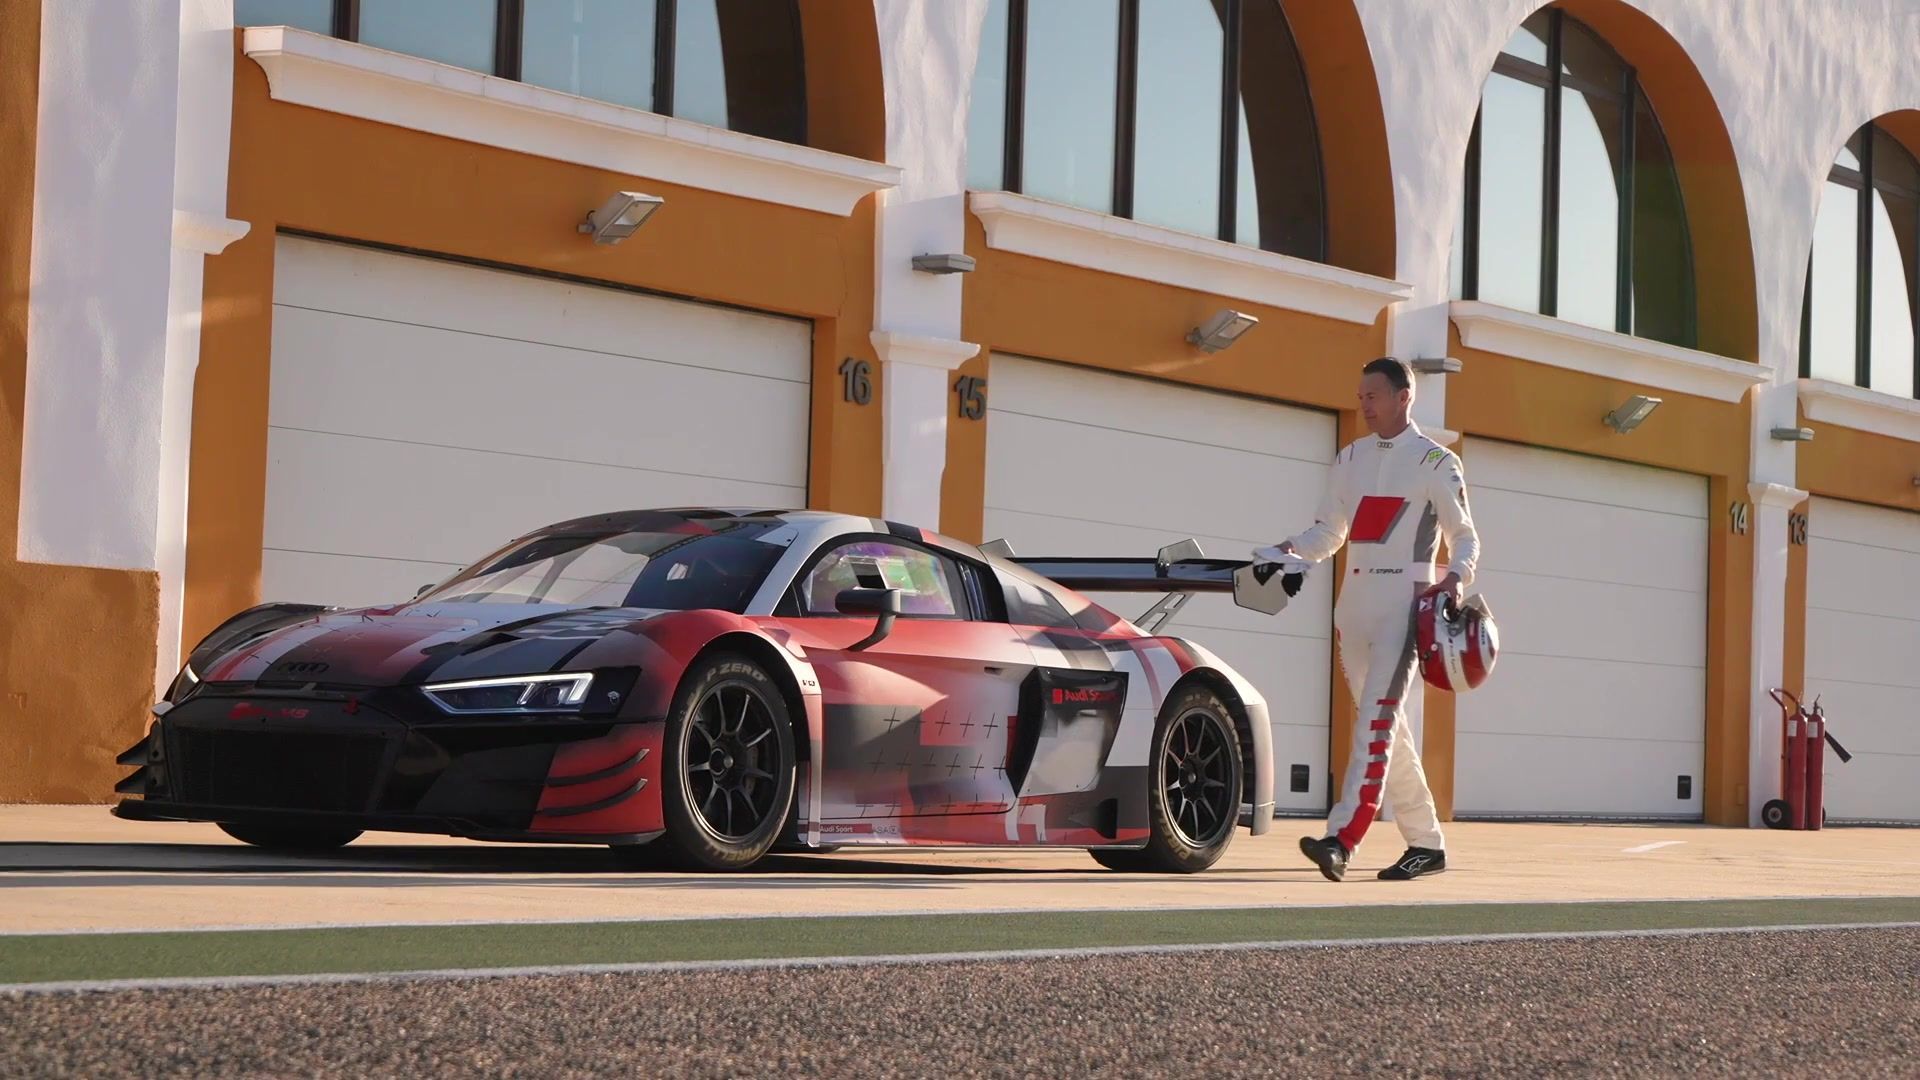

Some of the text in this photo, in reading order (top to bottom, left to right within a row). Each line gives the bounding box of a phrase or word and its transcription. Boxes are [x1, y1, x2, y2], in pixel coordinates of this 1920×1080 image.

[838, 357, 872, 405] 16
[953, 374, 986, 421] 15
[1730, 501, 1748, 536] 14
[1788, 512, 1809, 545] 13
[719, 662, 768, 683] ZERO
[1065, 688, 1089, 702] Audi
[820, 825, 854, 834] Audi Sport
